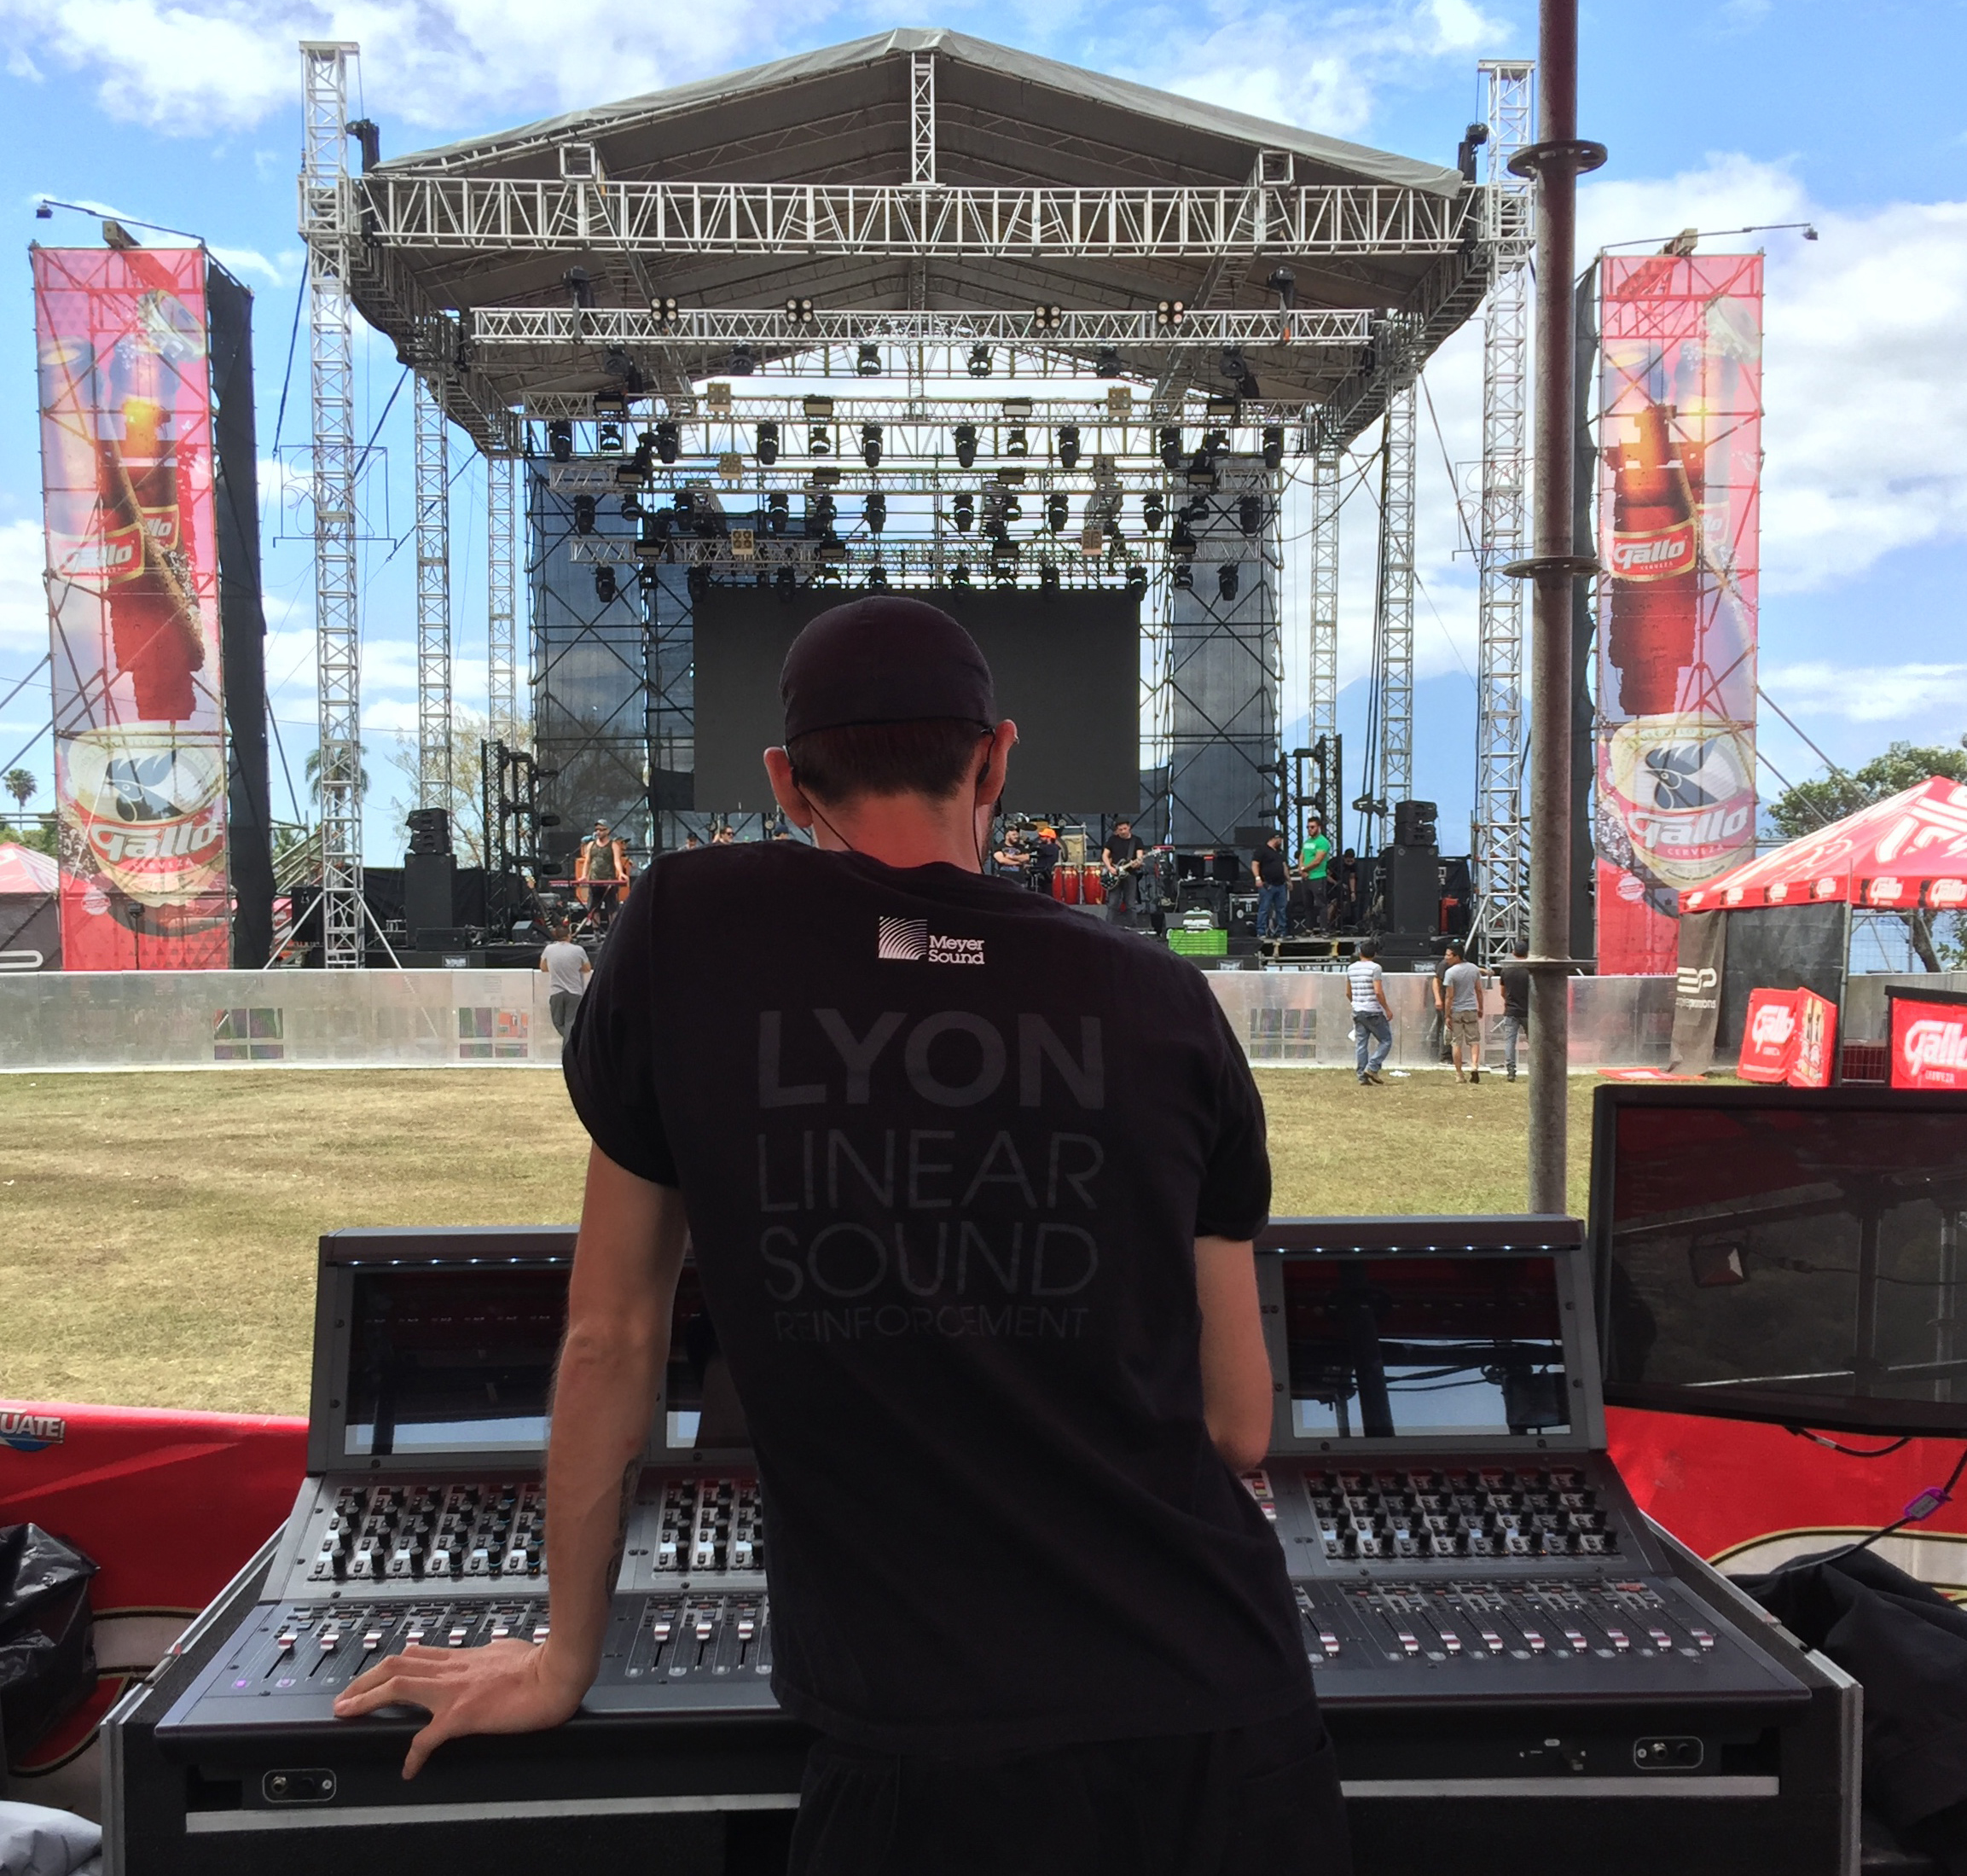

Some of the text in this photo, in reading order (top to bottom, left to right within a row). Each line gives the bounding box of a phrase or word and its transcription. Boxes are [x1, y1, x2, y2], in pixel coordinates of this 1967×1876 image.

[1614, 538, 1686, 569] Gallo
[90, 818, 220, 862] Gallo
[1628, 806, 1749, 847] Gallo
[1666, 844, 1726, 857] CERVEZA
[928, 935, 985, 952] Meyer
[928, 949, 985, 964] Sound
[758, 1008, 1105, 1109] LYON
[757, 1129, 1105, 1212] LINEAR
[759, 1221, 1099, 1302] SOUND
[774, 1305, 1091, 1343] REINFORCEMENT
[0, 1413, 66, 1443] UATE!
